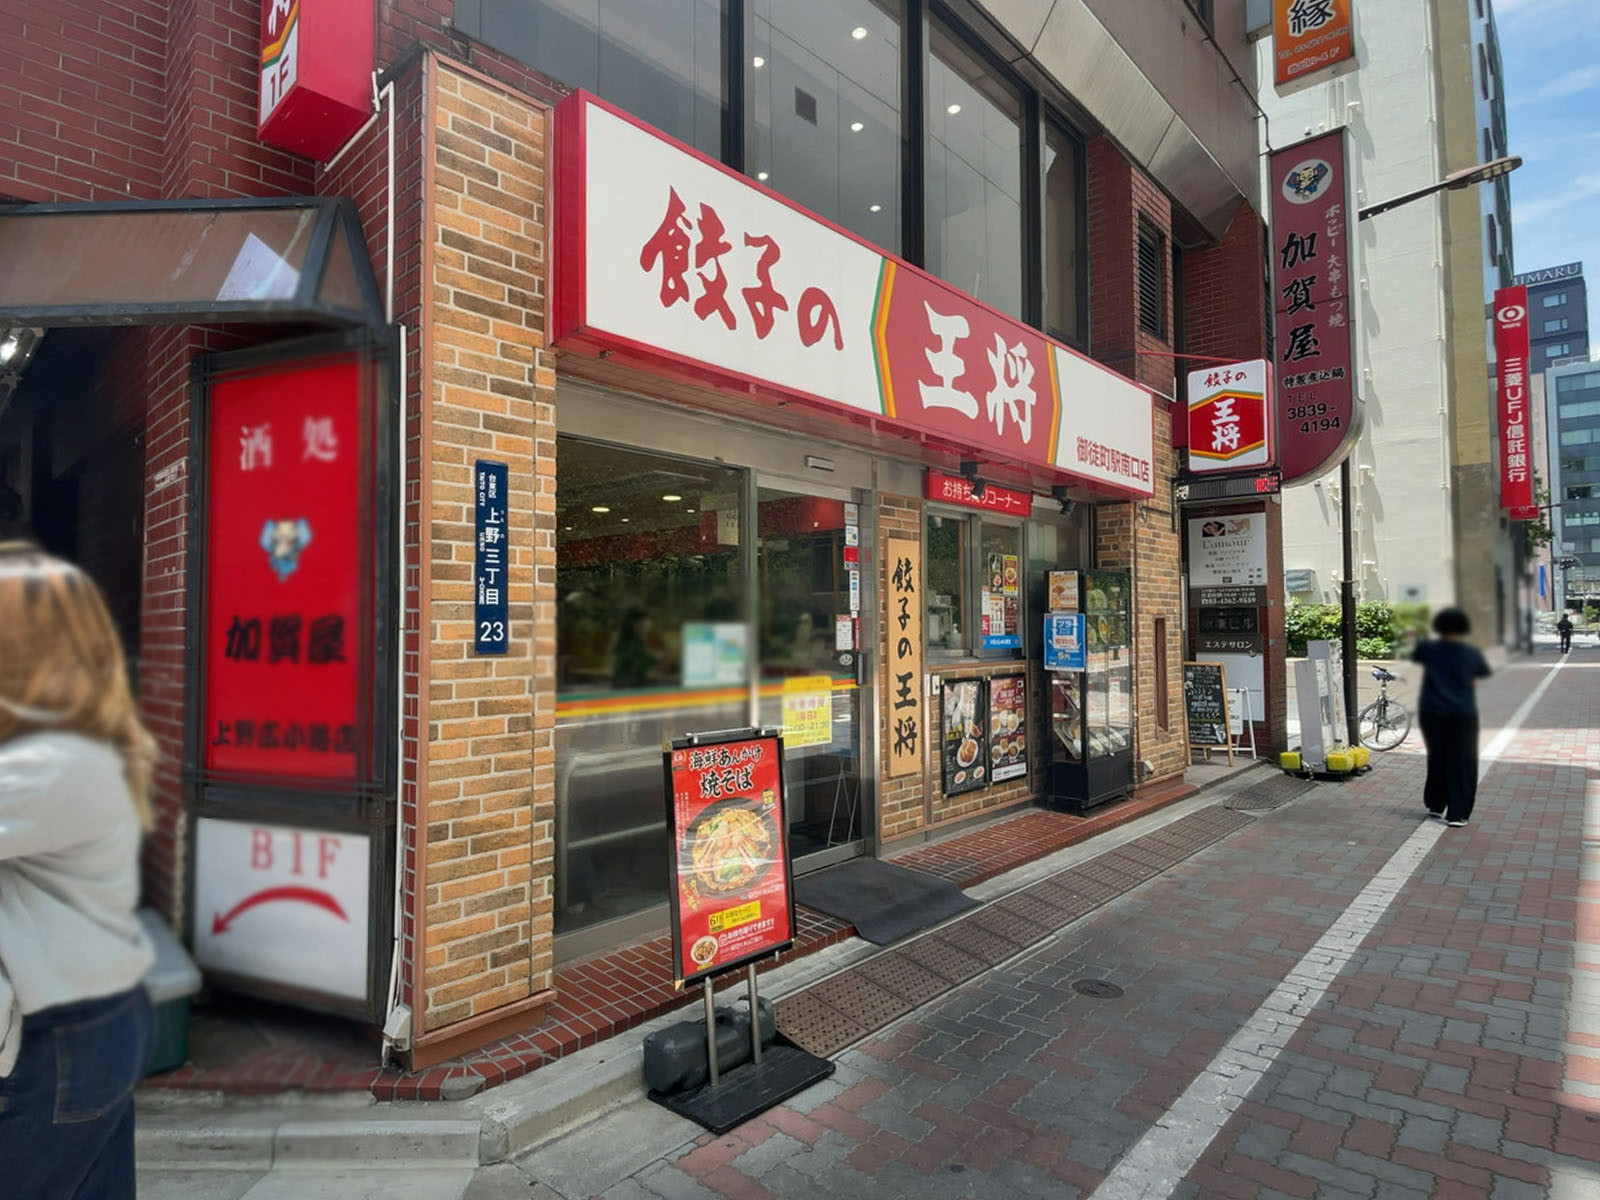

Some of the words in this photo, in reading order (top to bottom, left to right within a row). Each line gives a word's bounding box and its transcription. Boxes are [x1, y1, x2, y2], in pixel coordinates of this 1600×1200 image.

[640, 185, 844, 351] 餃子の
[918, 300, 1037, 444] 王将
[1280, 231, 1321, 363] 加賀屋
[1204, 370, 1247, 388] 餃子の
[1211, 398, 1241, 452] 王将
[1301, 416, 1341, 433] 4194
[1504, 357, 1527, 484] 三菱UFJ信託銀行
[1076, 436, 1150, 485] 御徒町駅南口店
[942, 479, 1022, 508] お持ちりコーナー
[485, 507, 500, 605] 上野三丁目
[224, 613, 348, 665] 加賀屋
[480, 621, 504, 642] 23
[1204, 639, 1254, 650] エステサロン
[891, 556, 918, 758] 餃子の王将
[700, 763, 755, 799] 焼そば
